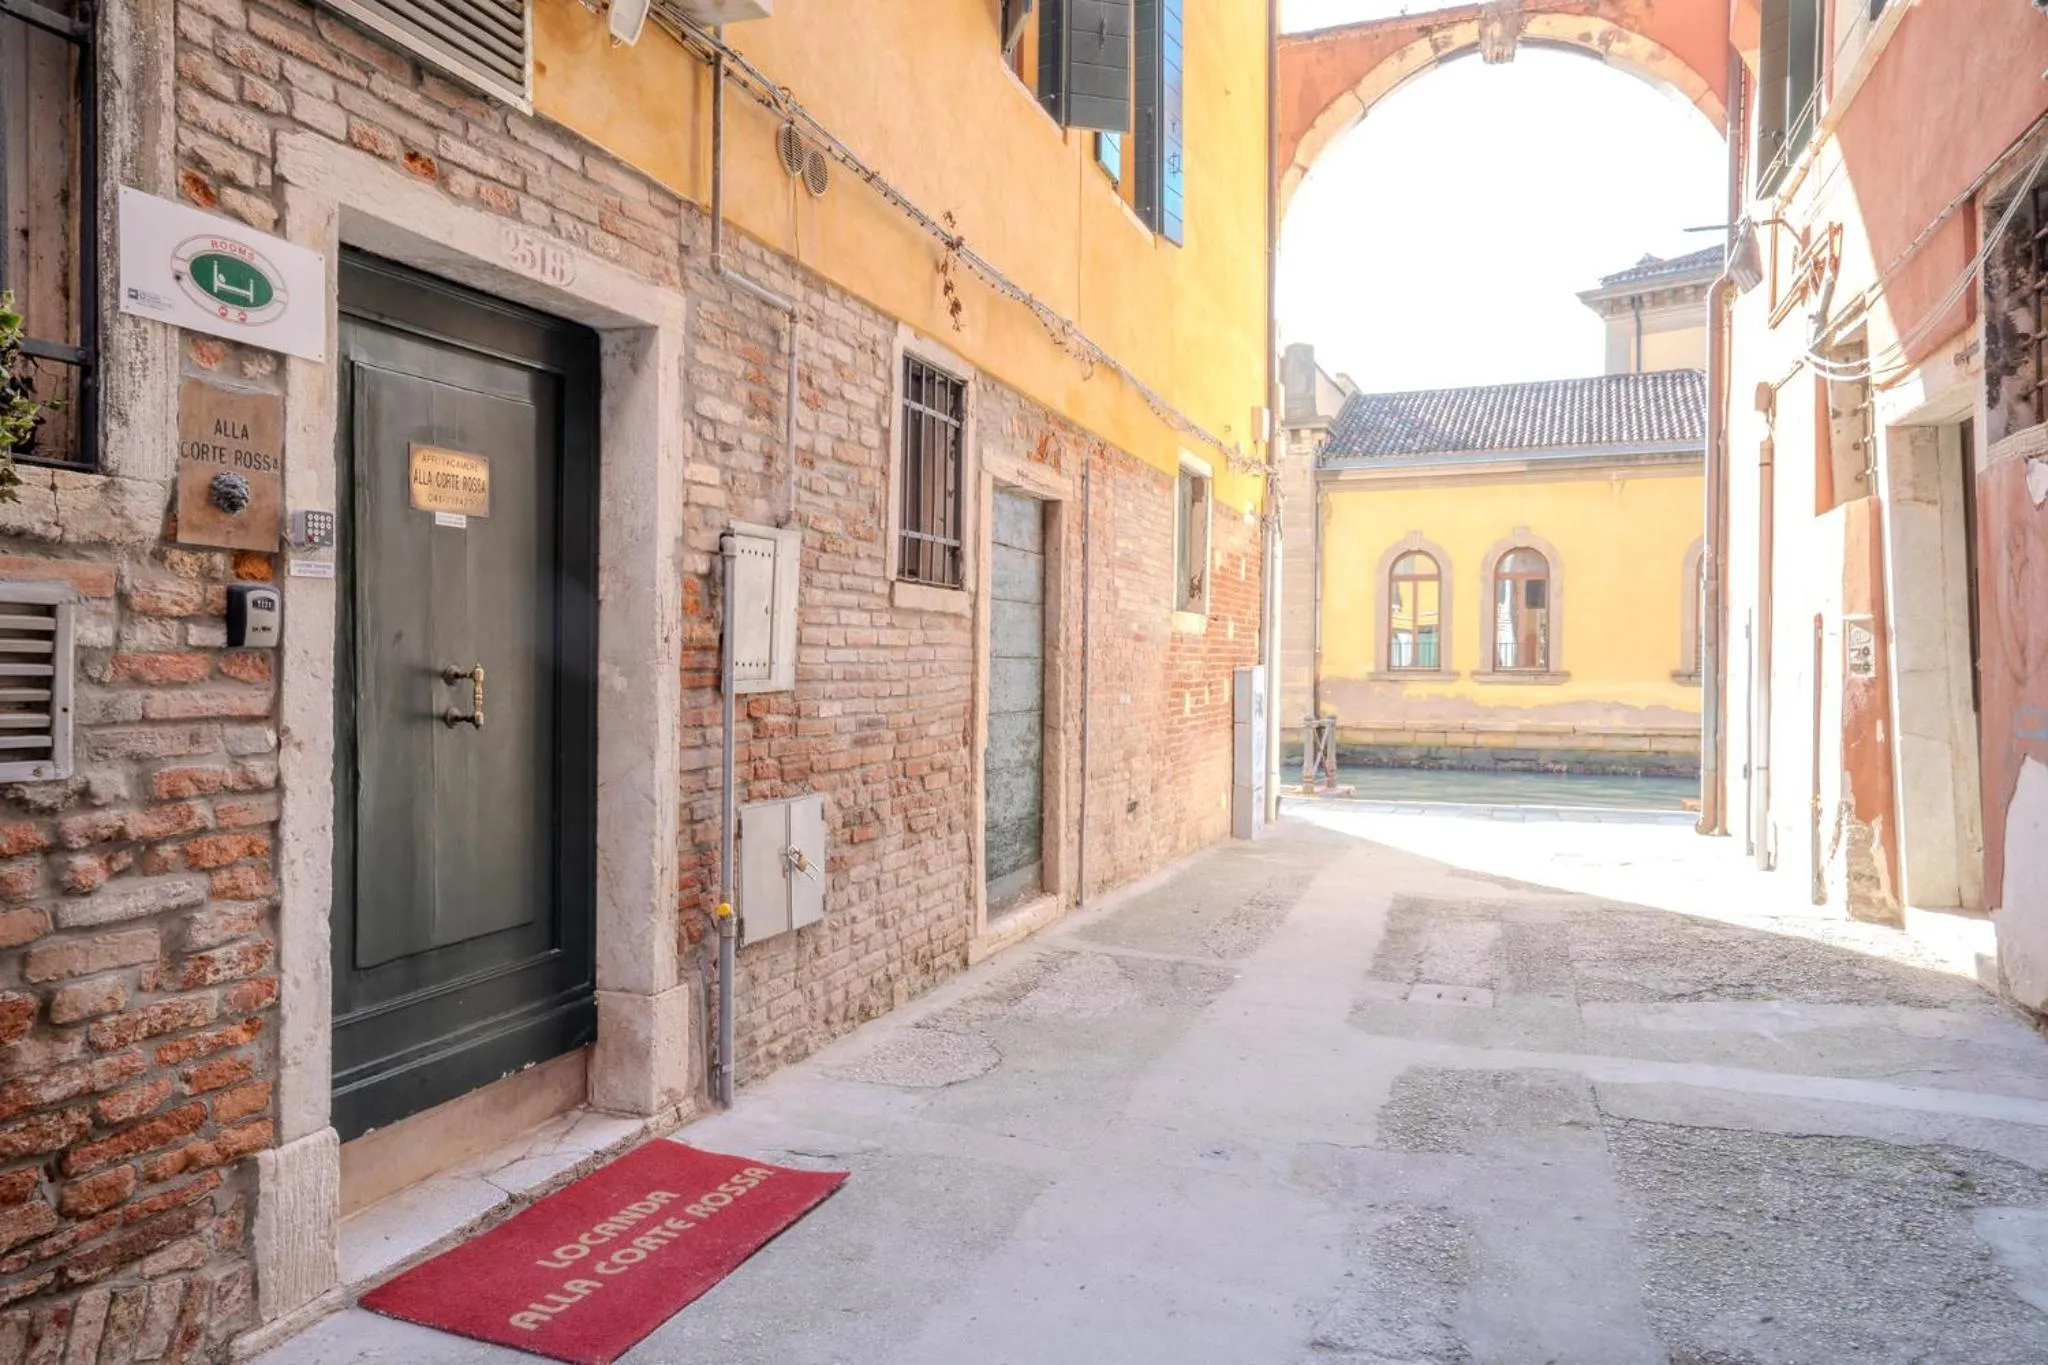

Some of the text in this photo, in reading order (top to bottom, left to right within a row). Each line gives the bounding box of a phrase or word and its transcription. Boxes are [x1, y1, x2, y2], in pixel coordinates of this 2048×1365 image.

[210, 239, 255, 261] ROOMS
[509, 230, 565, 282] 2518
[214, 418, 250, 441] ALLA
[180, 440, 228, 465] CORTE
[413, 467, 486, 494] ALLA CORTE ROSSA
[536, 1190, 681, 1269] LOCANDA
[508, 1166, 776, 1332] ALLA CORTE ROSSA
